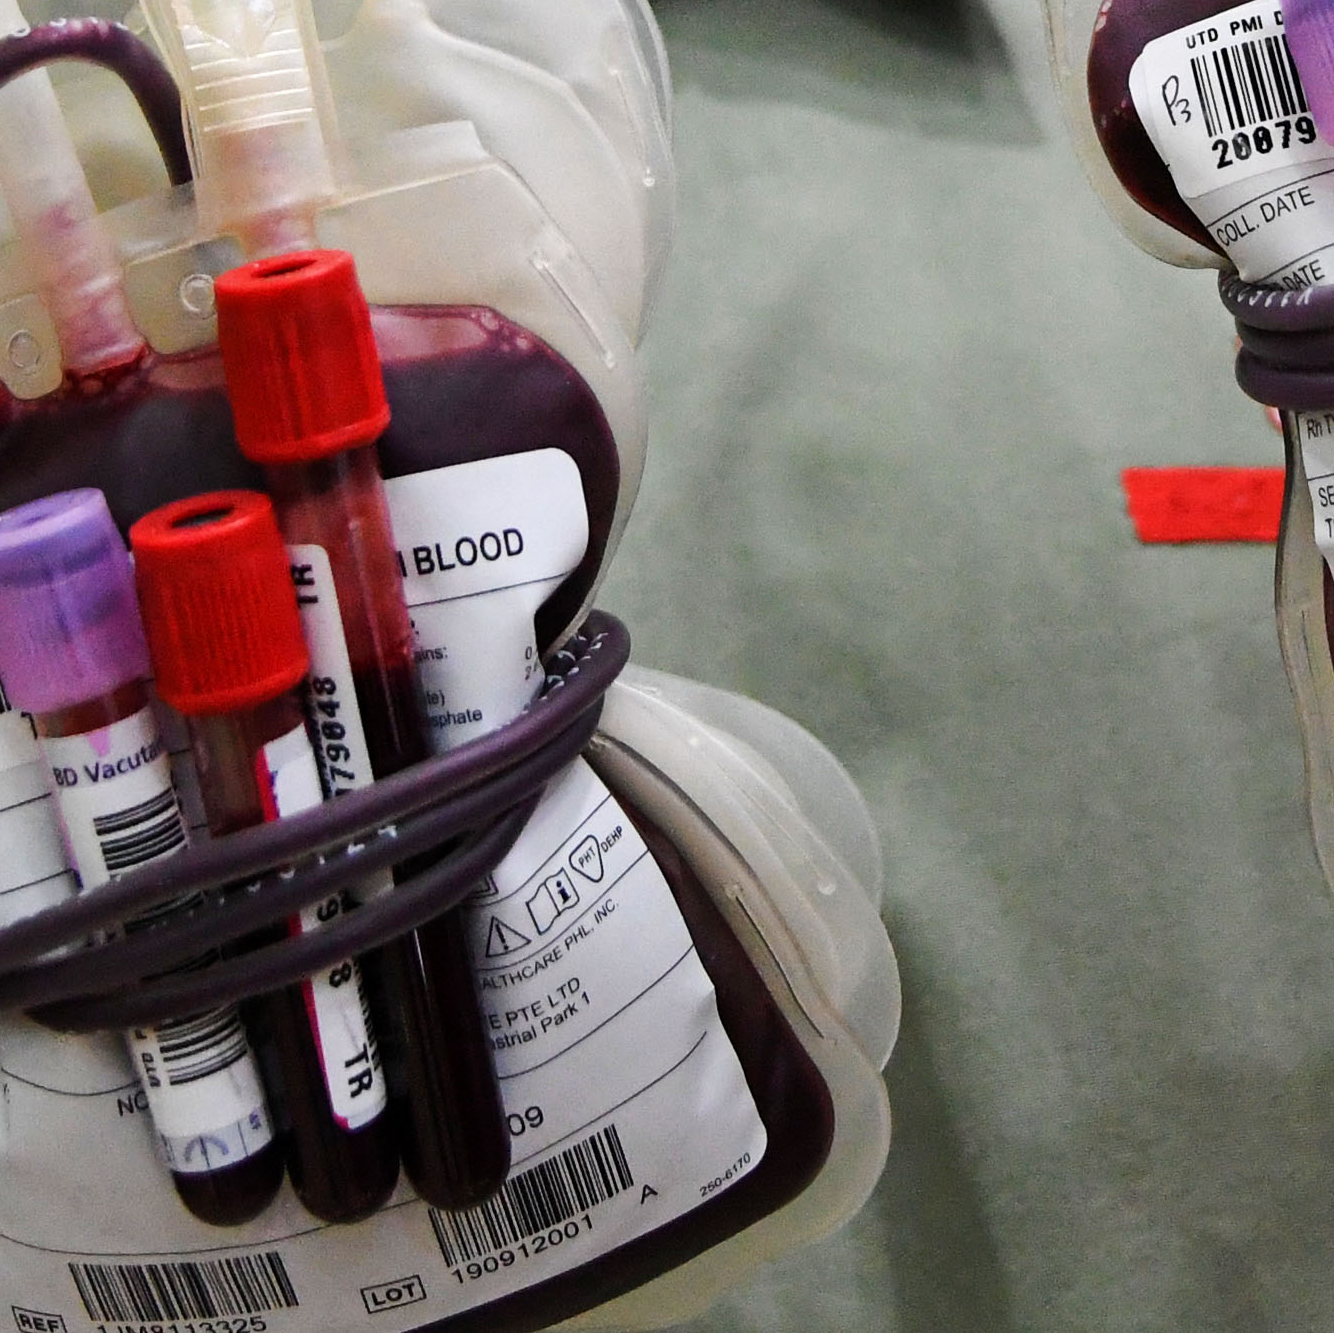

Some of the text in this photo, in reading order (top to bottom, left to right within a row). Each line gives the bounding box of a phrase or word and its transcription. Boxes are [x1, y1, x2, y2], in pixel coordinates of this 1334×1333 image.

[1186, 28, 1219, 49] UTD
[1230, 15, 1263, 35] PMI
[1211, 117, 1317, 169] 20079
[1216, 186, 1315, 248] COLL. DATE
[413, 528, 524, 576] BLOOD
[600, 825, 624, 853] DEHP
[565, 926, 594, 951] PHL.
[595, 898, 619, 924] INC.
[506, 1001, 544, 1028] PTE
[547, 977, 580, 1008] LTD
[542, 1002, 578, 1034] Park
[699, 1152, 752, 1197] 250-6170
[451, 1184, 659, 1284] 190912001 A
[371, 1284, 415, 1308] LOT
[19, 1315, 59, 1333] REF
